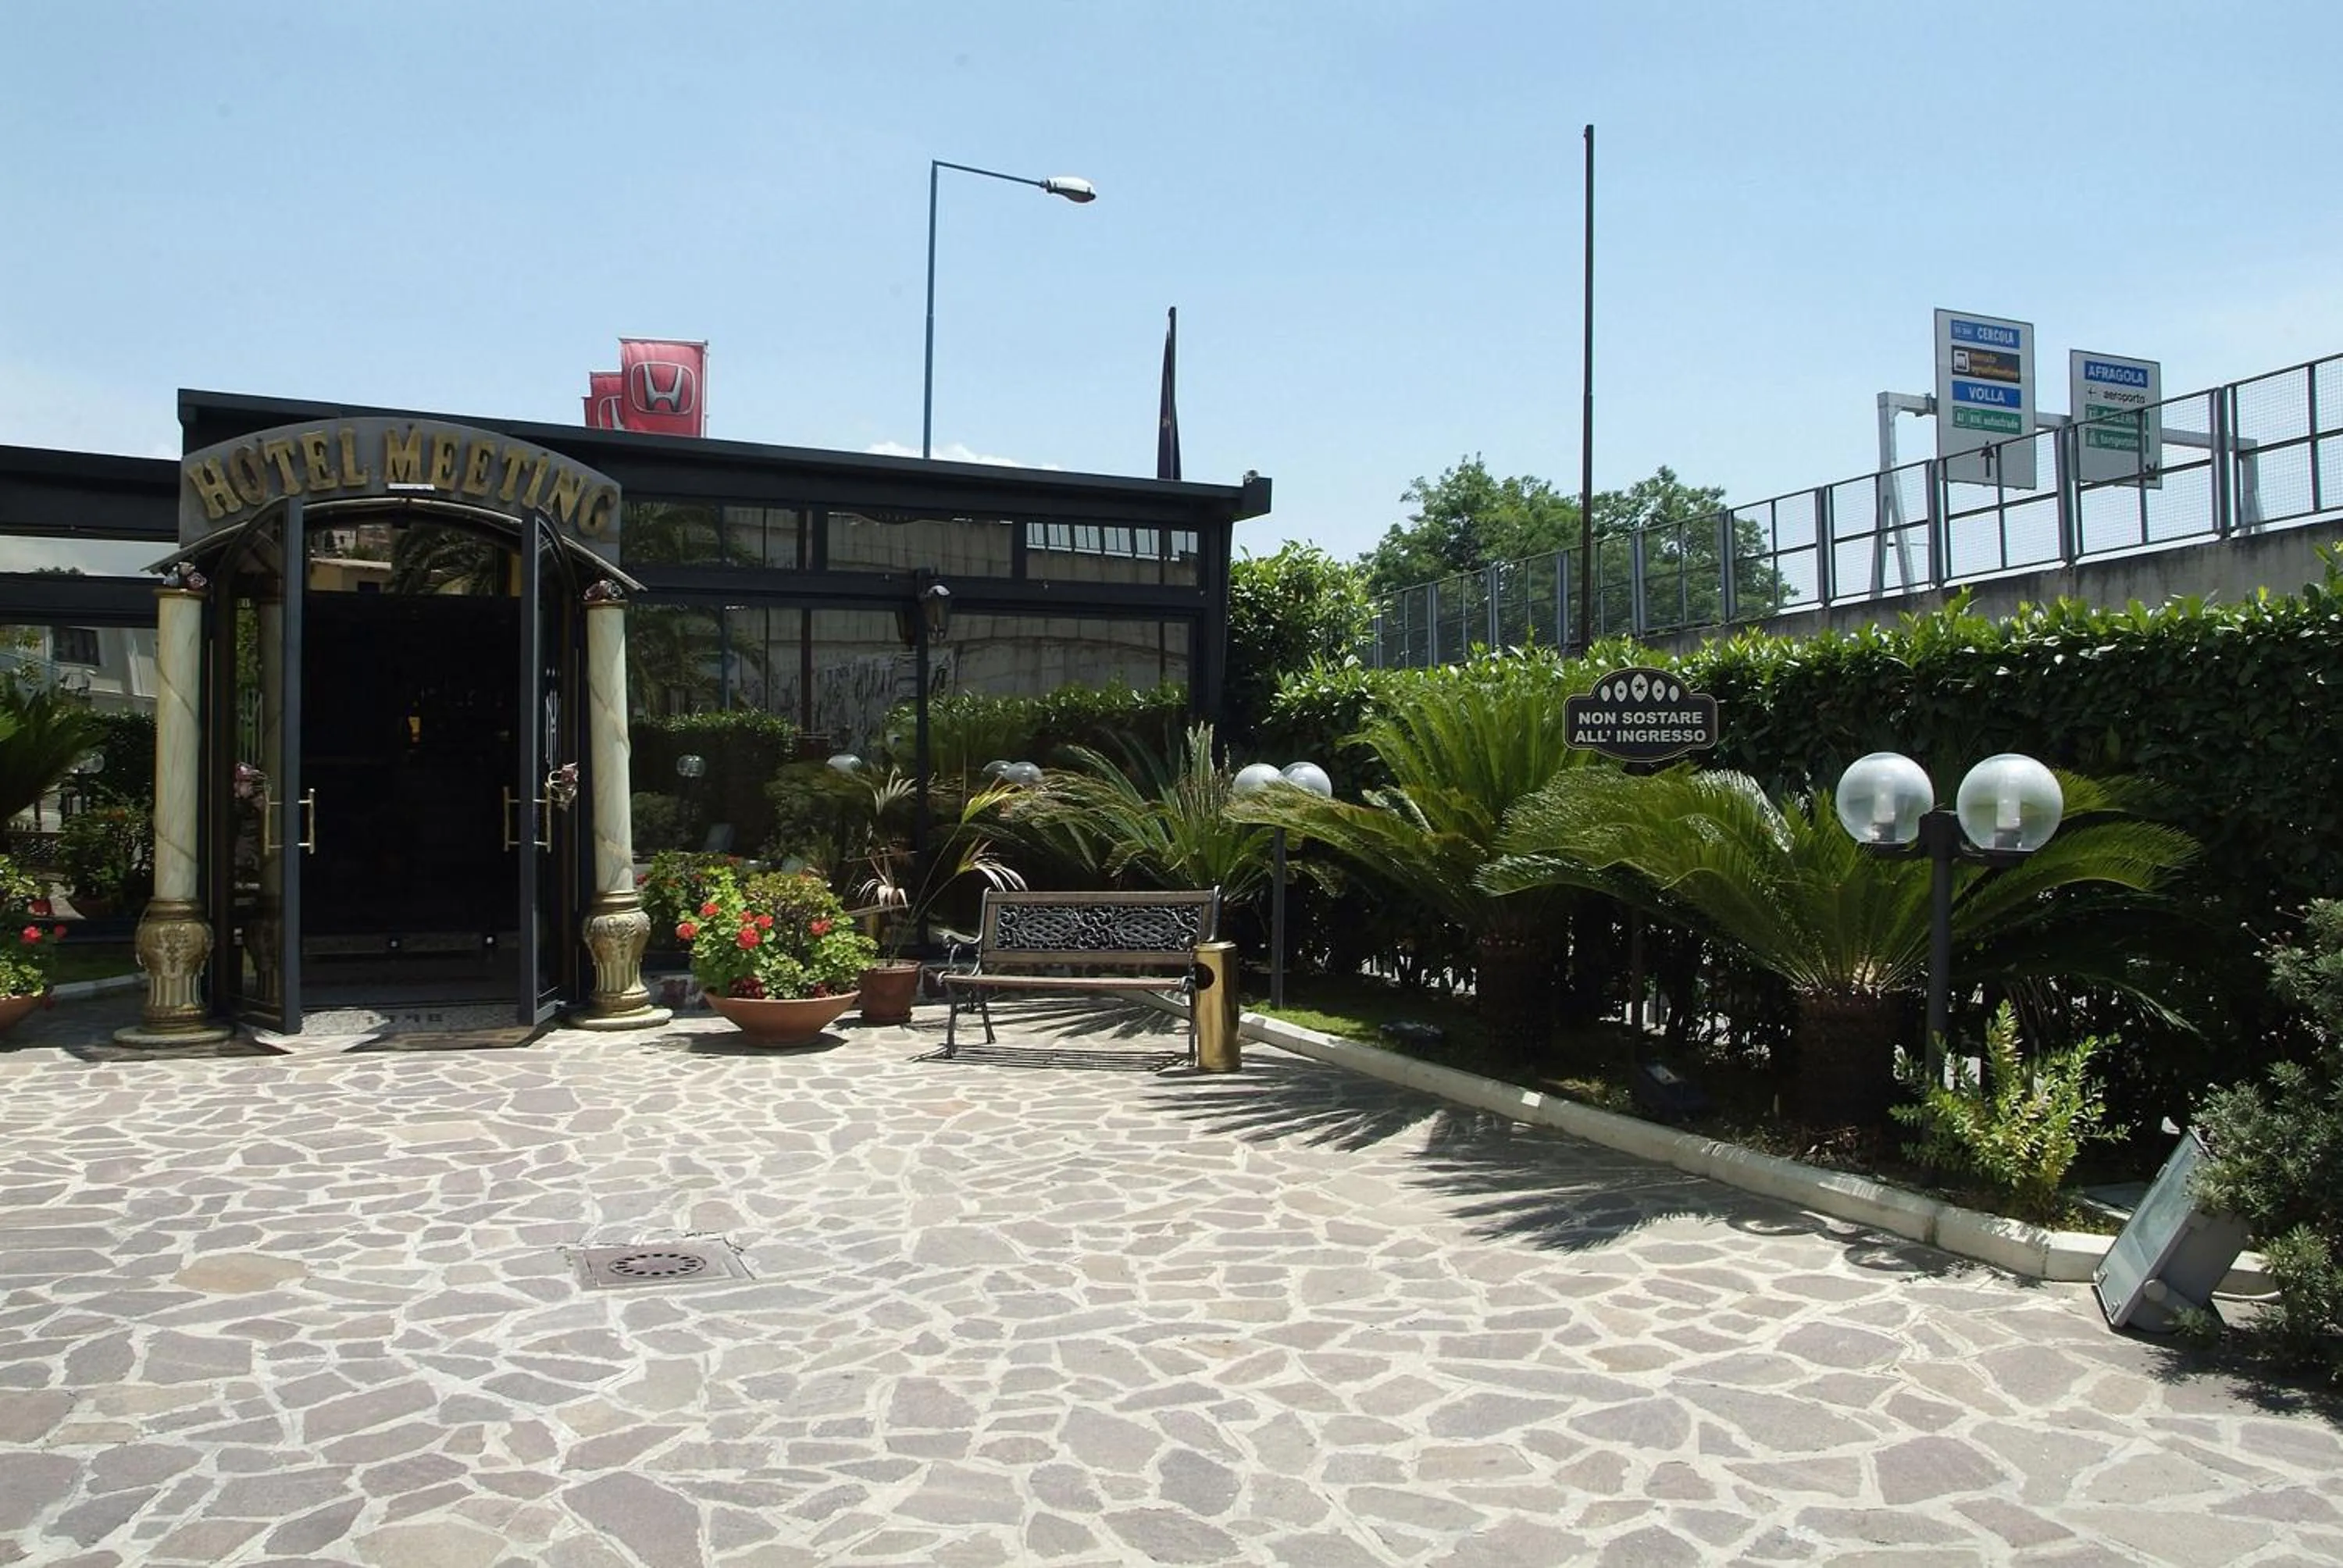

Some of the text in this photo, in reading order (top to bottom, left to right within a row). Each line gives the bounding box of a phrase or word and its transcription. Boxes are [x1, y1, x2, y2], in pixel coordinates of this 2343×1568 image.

[2088, 364, 2145, 384] AFRAGOLA
[1968, 387, 2006, 404] VOLLA
[187, 426, 620, 539] HOTEL MEETING
[1578, 711, 1703, 725] NON SOSTARE
[1574, 729, 1706, 743] ALL' INGRESSO
